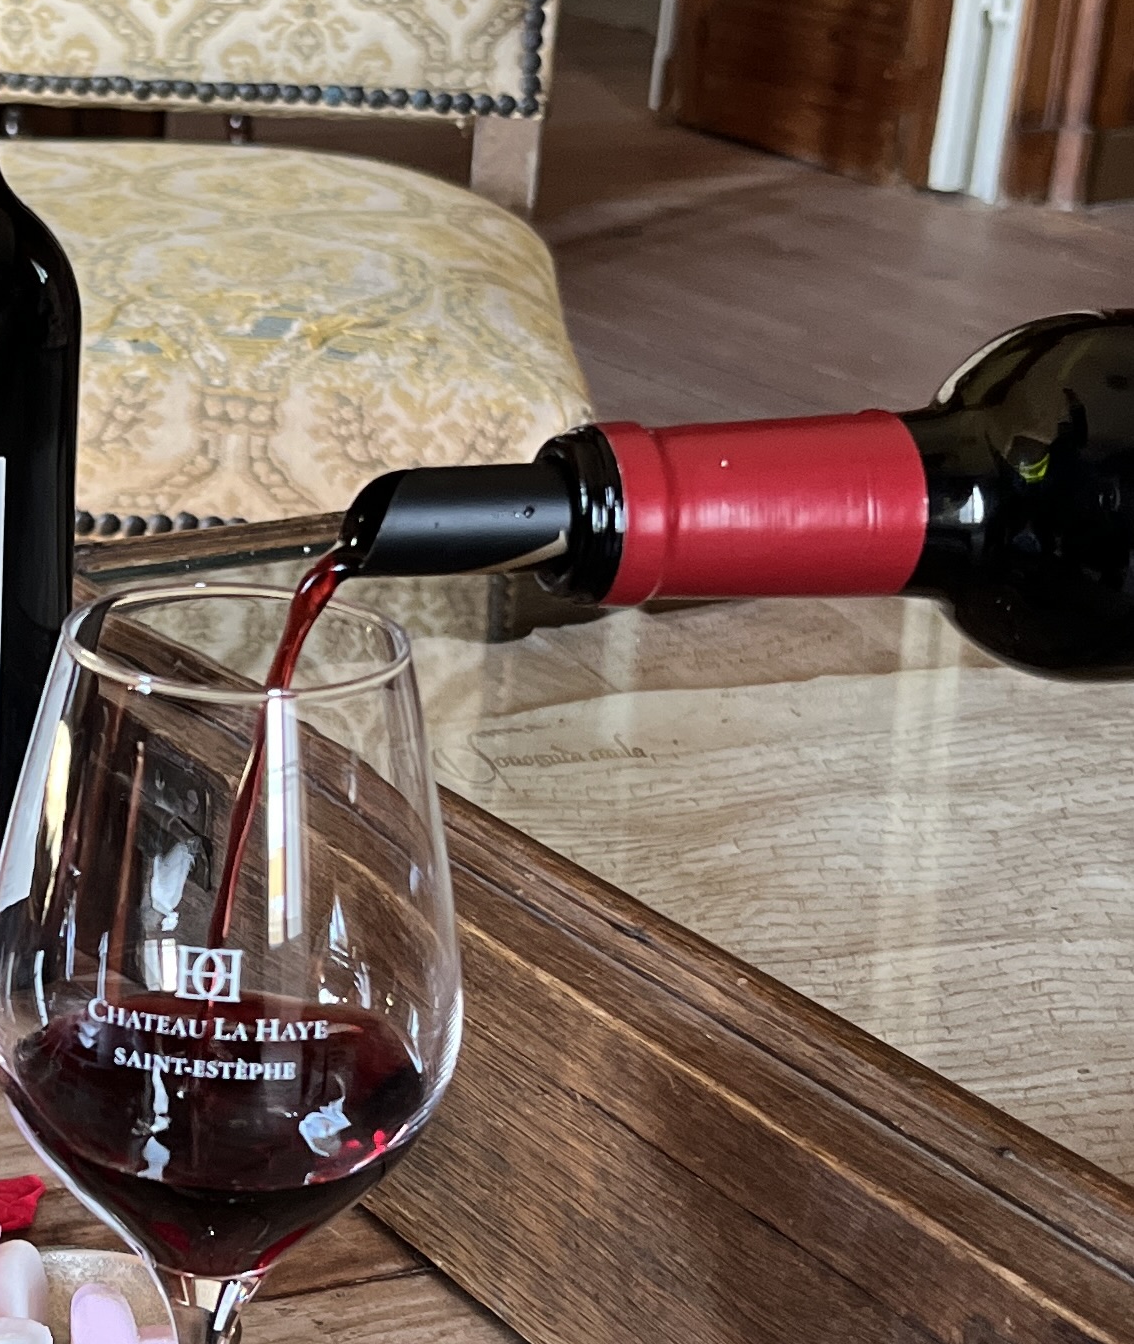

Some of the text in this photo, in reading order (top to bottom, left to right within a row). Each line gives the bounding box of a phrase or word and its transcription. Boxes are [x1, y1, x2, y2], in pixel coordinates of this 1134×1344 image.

[88, 997, 330, 1043] CHATEAU LA HAYE
[114, 1046, 297, 1082] SAINT-ESTÈPHE
